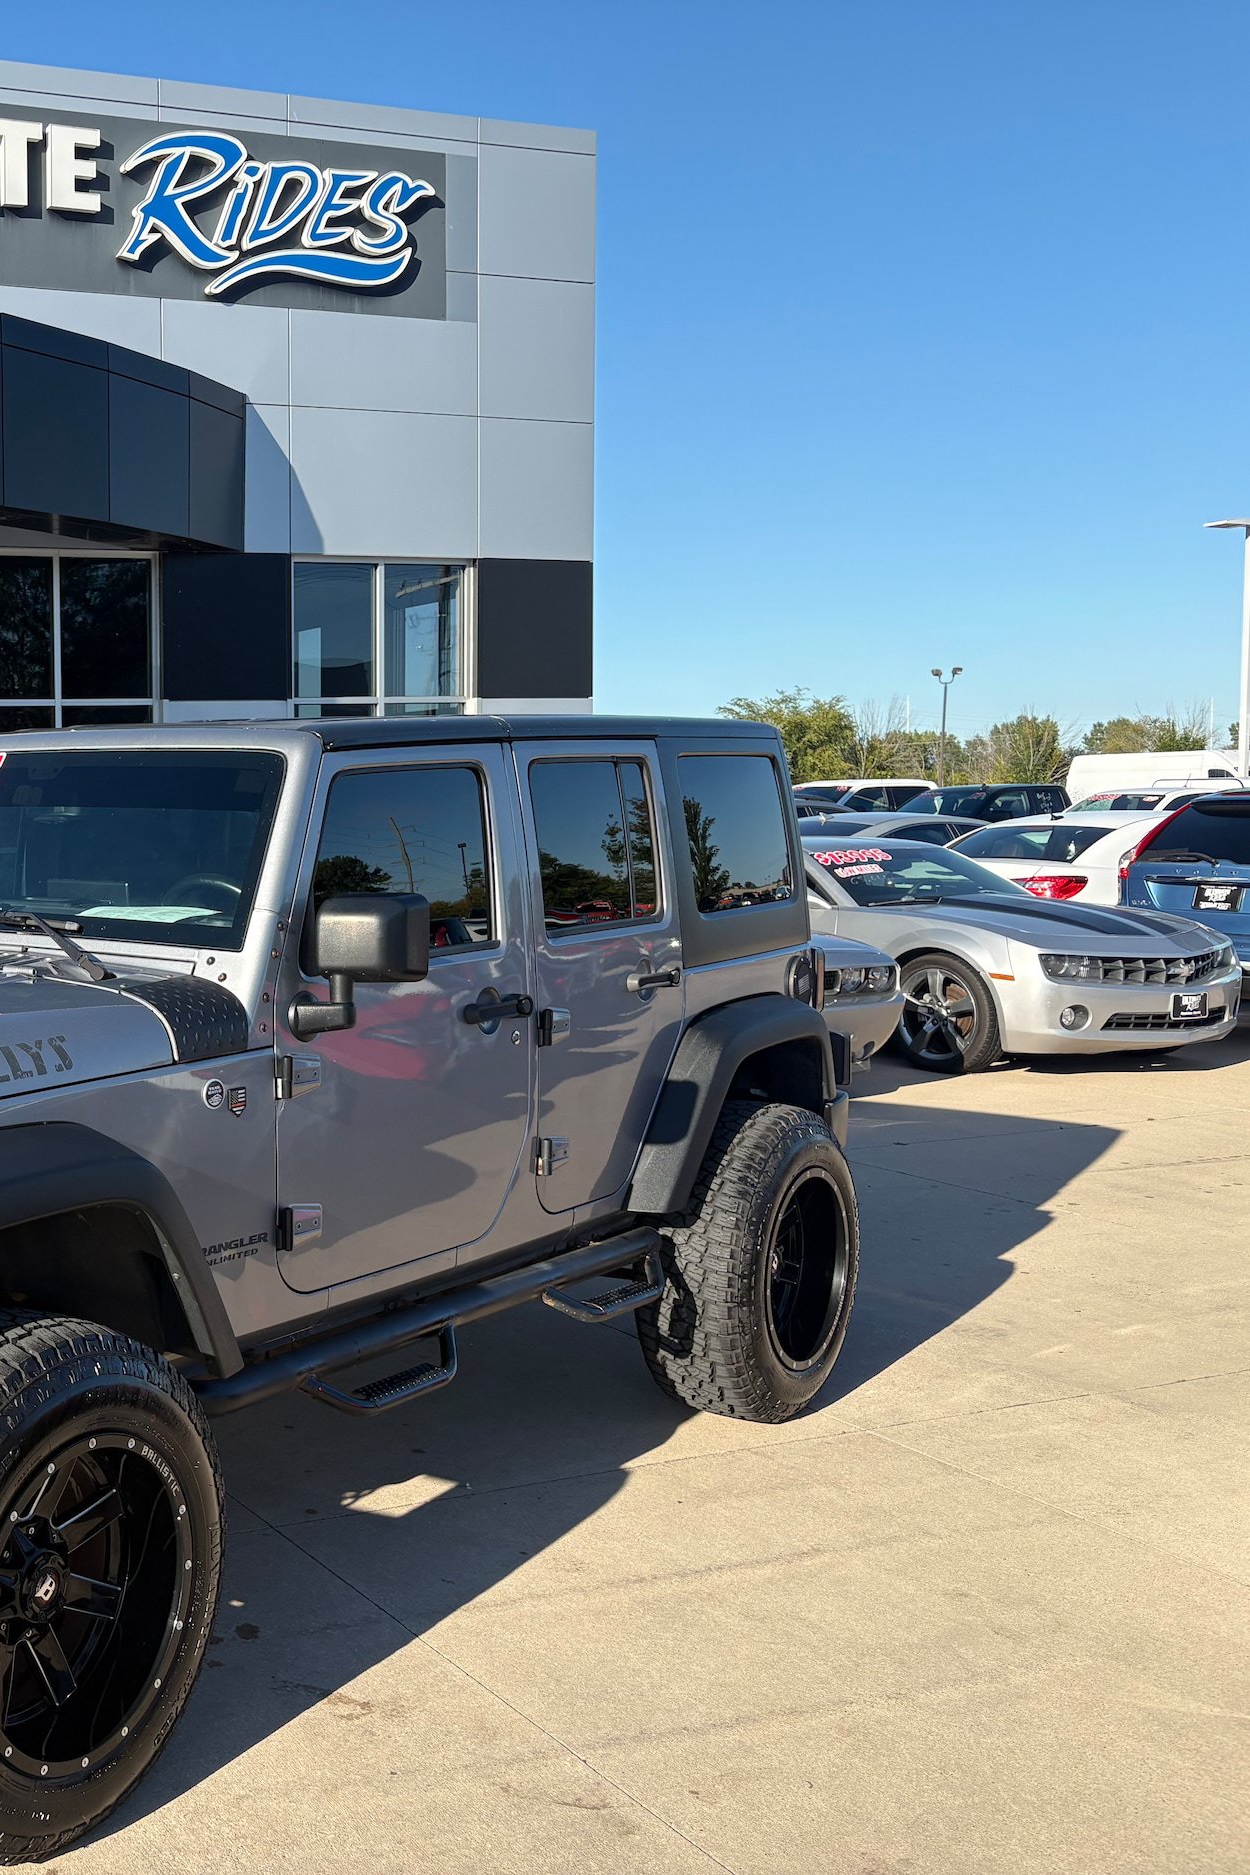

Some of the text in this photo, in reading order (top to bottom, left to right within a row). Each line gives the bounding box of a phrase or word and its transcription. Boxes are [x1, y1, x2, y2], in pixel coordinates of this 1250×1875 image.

[813, 848, 893, 866] $13995
[201, 1232, 269, 1257] RANGLER
[206, 1248, 258, 1266] NLIMITED
[141, 1445, 180, 1497] BALLISTIC
